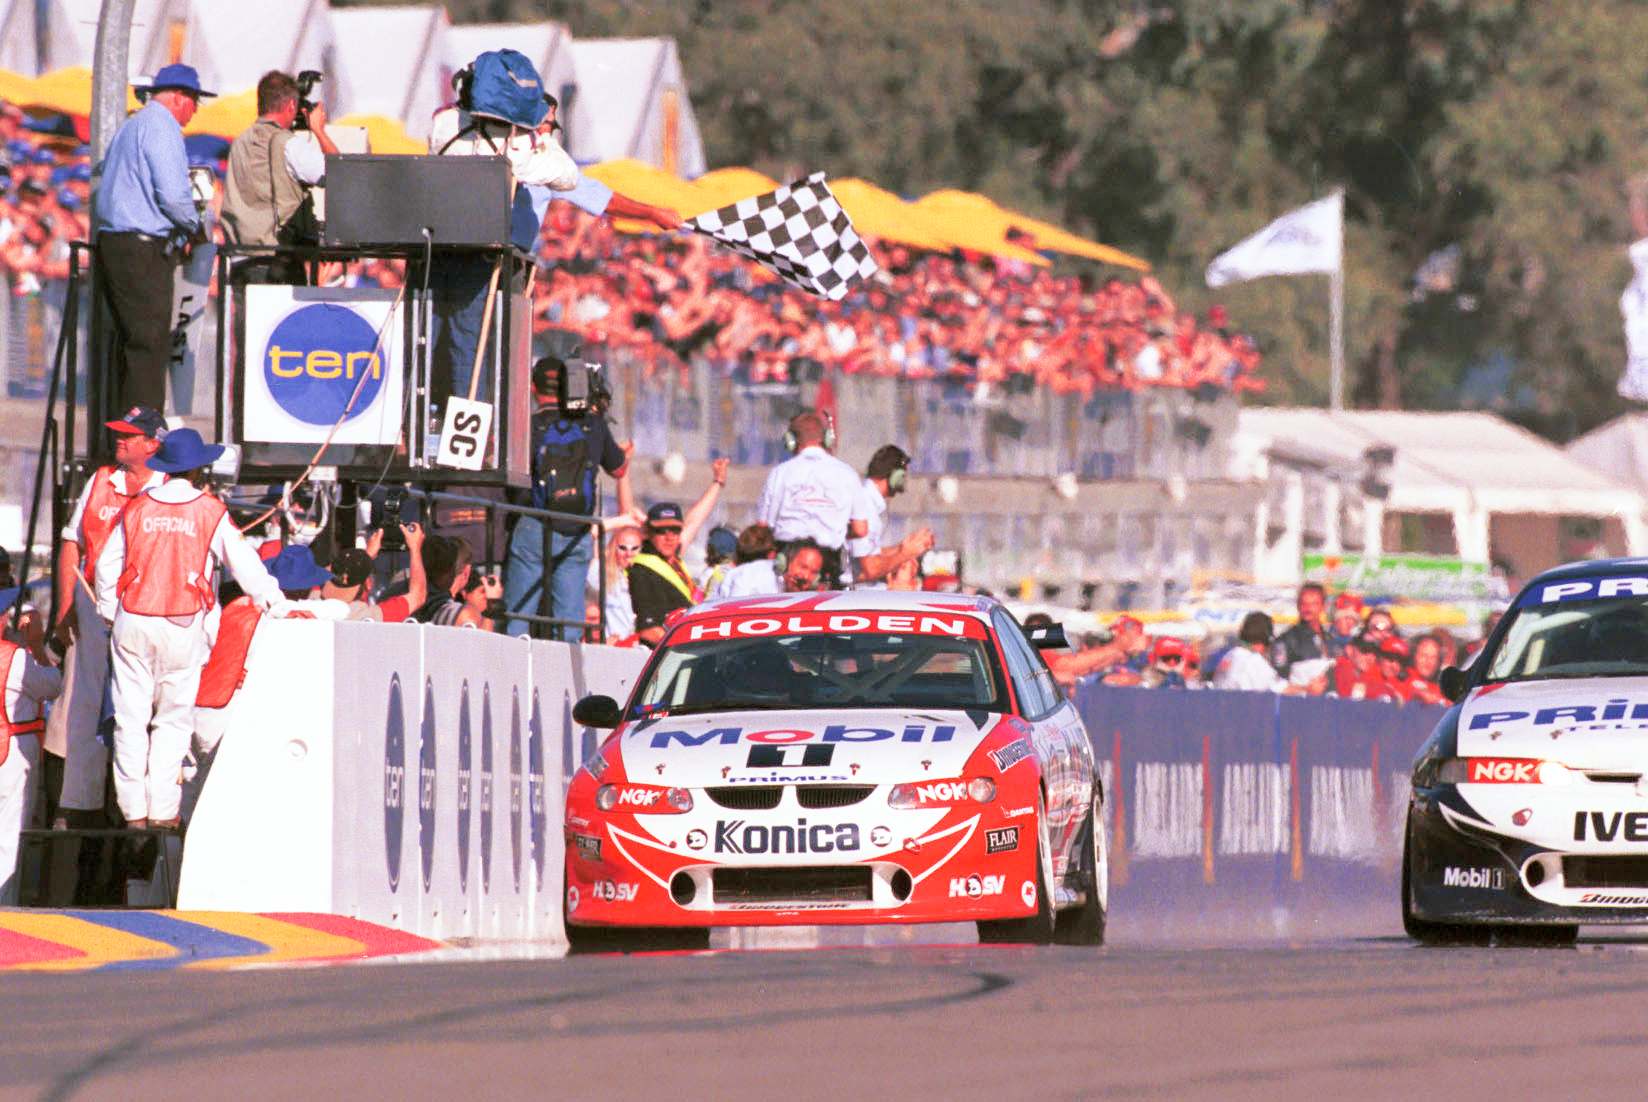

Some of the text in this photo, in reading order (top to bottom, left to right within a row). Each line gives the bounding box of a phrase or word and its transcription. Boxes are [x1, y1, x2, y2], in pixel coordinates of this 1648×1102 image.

[268, 345, 380, 379] ten
[449, 411, 481, 457] SC
[142, 516, 197, 537] OFFICIAL
[690, 615, 965, 640] HOLDEN
[649, 725, 956, 748] Mobil
[1474, 762, 1534, 781] NGK
[916, 782, 968, 804] NGK
[714, 818, 861, 854] Konica
[989, 829, 1017, 847] FLAIR
[1443, 868, 1491, 888] Mobil
